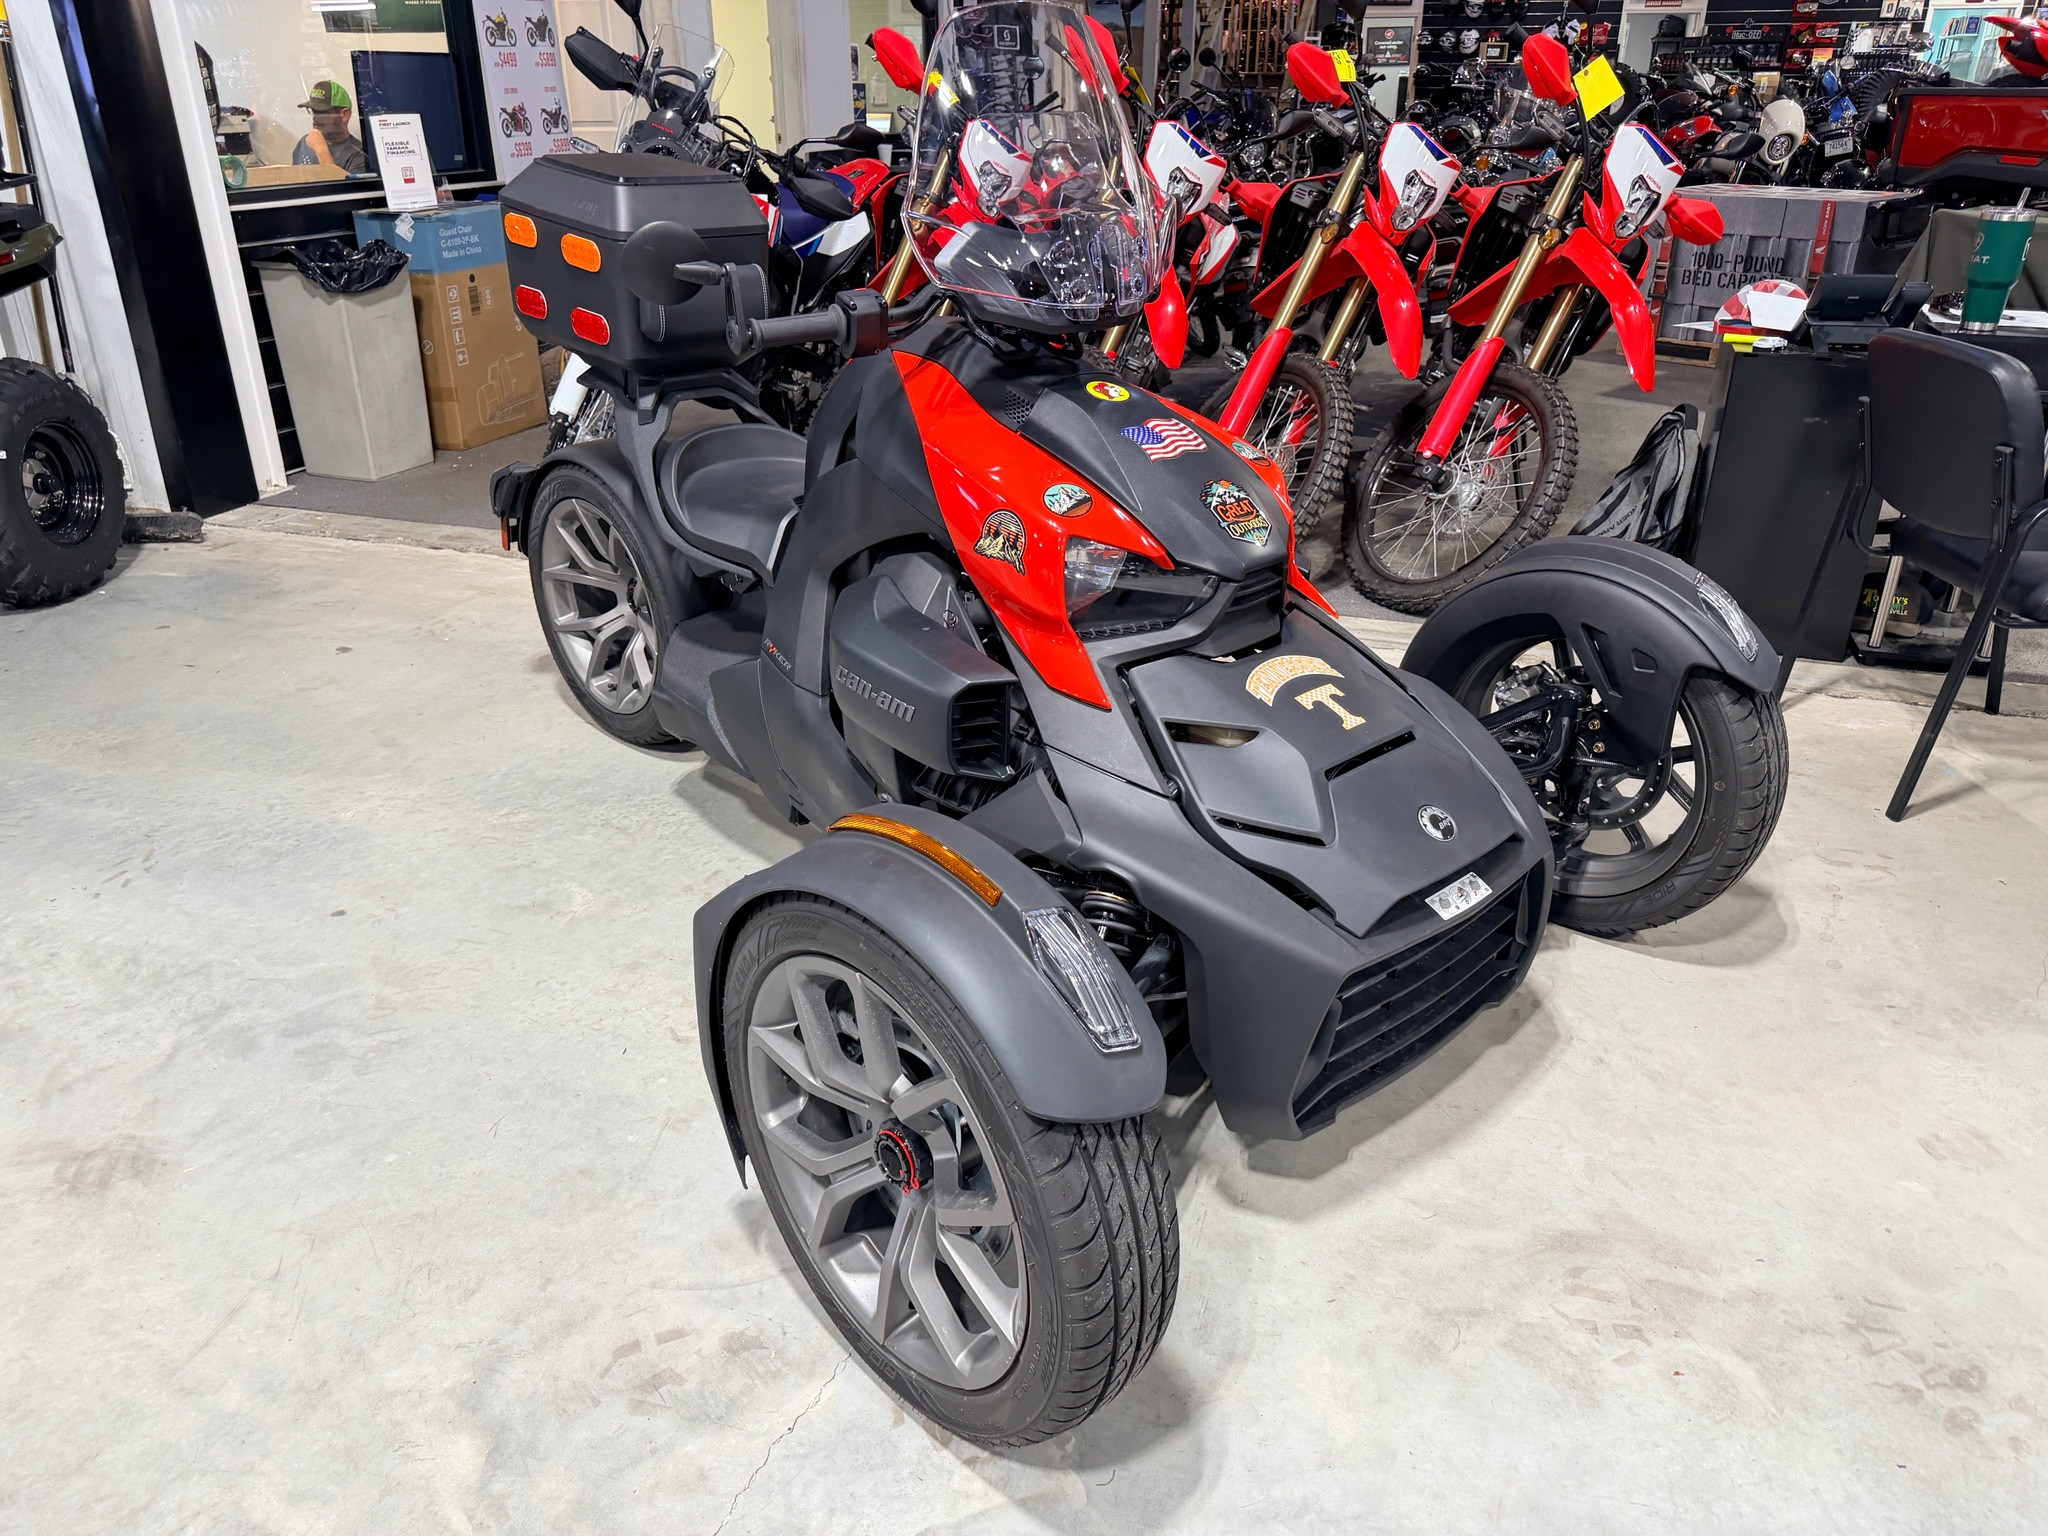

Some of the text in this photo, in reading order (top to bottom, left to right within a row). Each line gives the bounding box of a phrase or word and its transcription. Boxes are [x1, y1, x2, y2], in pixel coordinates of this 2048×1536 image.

[1732, 30, 1762, 40] Muc-Off
[651, 121, 675, 135] HONDA
[1183, 166, 1201, 181] HONDA
[1420, 169, 1437, 185] HONDA
[1645, 174, 1662, 191] HONDA
[439, 224, 473, 237] Guest Chair
[442, 246, 482, 259] Made in China
[1691, 251, 1786, 274] 1000-POUND
[1682, 270, 1794, 290] BED CAPA
[1217, 499, 1255, 522] GREAT
[1616, 505, 1638, 526] NDER
[1229, 515, 1268, 537] OUTDOORS
[764, 637, 792, 672] RYKER
[1245, 655, 1345, 707] TENNESSEE
[835, 664, 916, 723] can-am
[1439, 817, 1451, 830] BRP
[1642, 880, 1677, 907] RIDE
